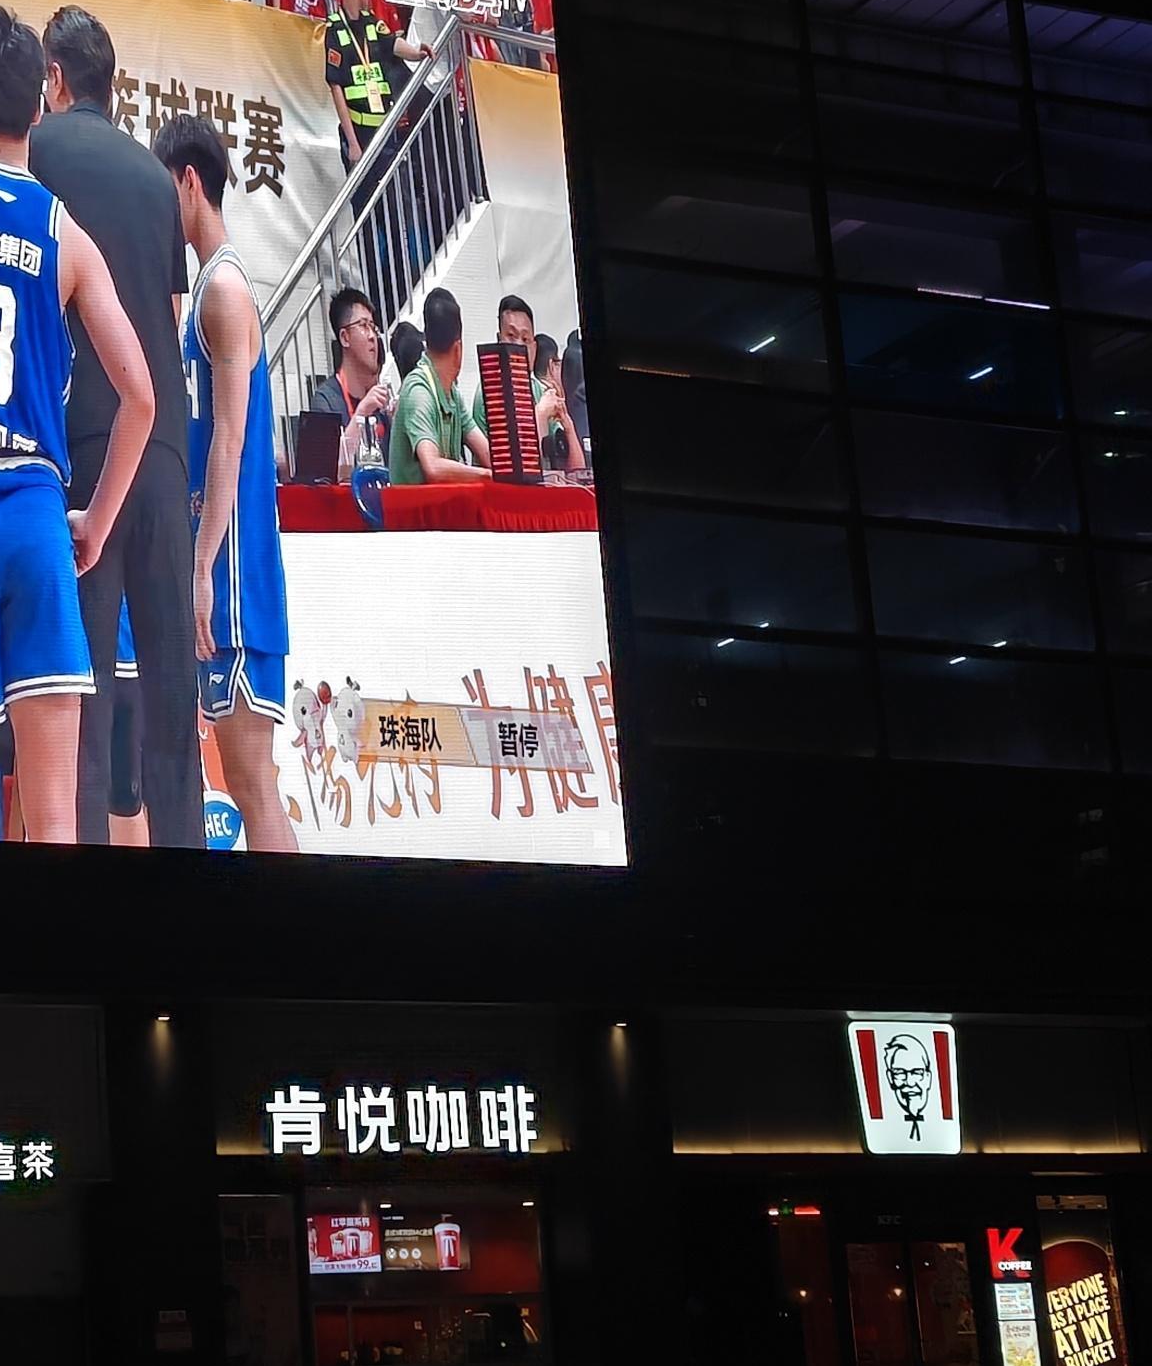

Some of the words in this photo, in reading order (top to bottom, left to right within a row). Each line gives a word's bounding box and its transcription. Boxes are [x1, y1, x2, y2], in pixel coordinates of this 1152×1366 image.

[378, 714, 442, 753] 珠海队
[498, 721, 539, 759] 暂停
[265, 1085, 539, 1155] 肯悦咖啡
[1077, 1294, 1111, 1321] PLACE
[1054, 1323, 1081, 1359] AT
[1080, 1311, 1113, 1347] MY
